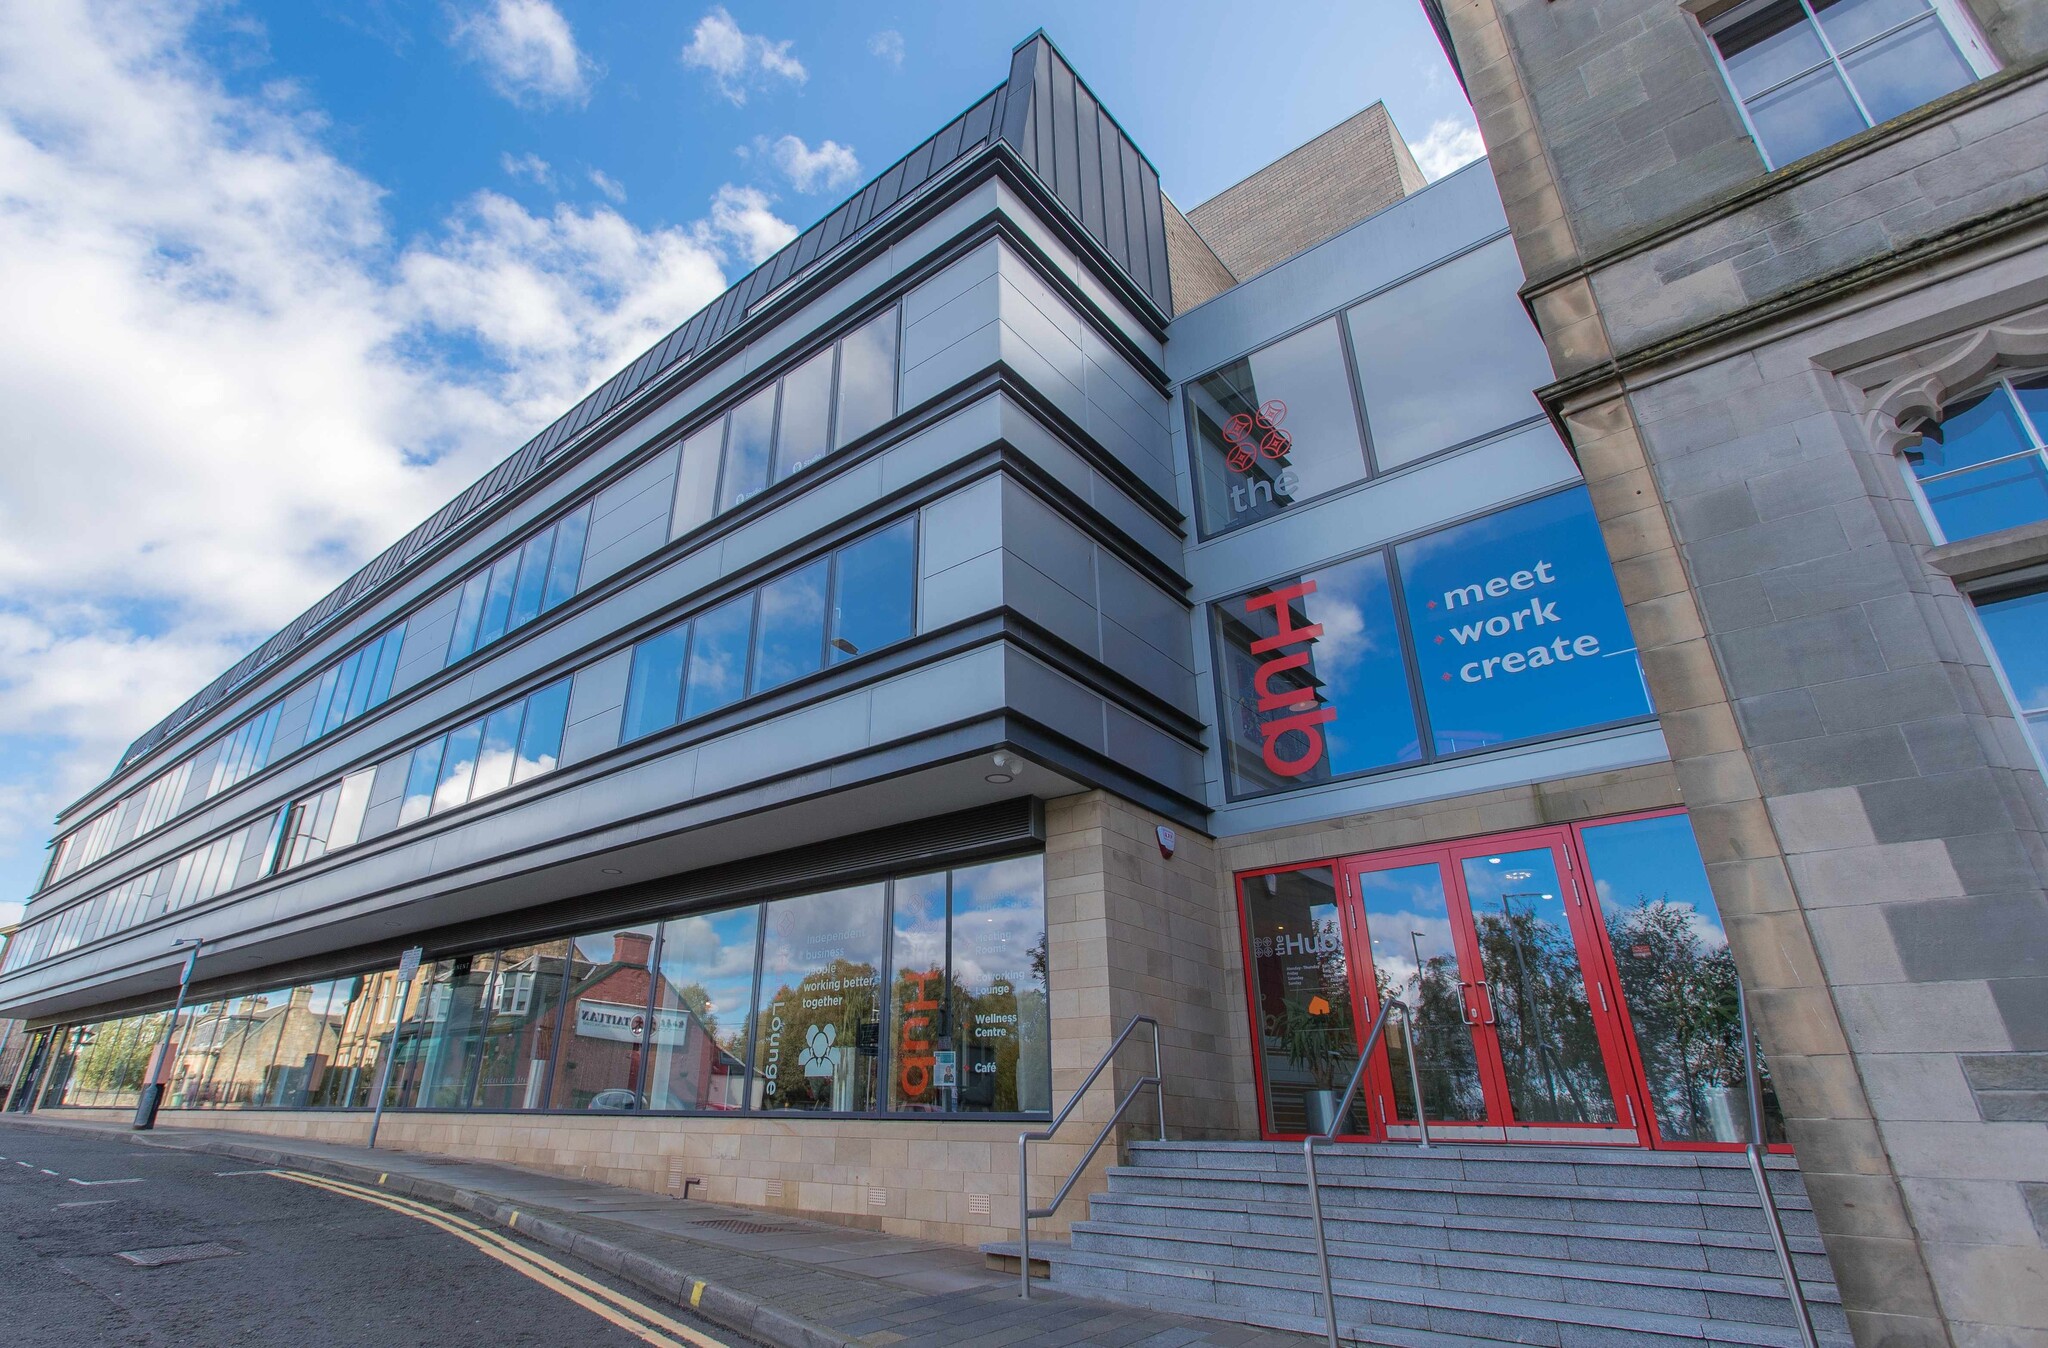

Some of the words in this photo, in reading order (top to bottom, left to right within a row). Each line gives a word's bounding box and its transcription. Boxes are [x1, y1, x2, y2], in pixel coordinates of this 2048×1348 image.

[1230, 471, 1299, 513] the
[1444, 560, 1555, 610] meet
[1449, 597, 1562, 645] work
[1460, 634, 1600, 683] create
[1245, 580, 1338, 777] Hub
[806, 929, 865, 945] Independent
[1275, 935, 1286, 956] the
[1286, 933, 1338, 956] Hub
[805, 947, 845, 960] business
[975, 944, 1007, 955] Rooms
[803, 963, 837, 977] people
[803, 979, 841, 992] working
[843, 976, 876, 989] better,
[975, 985, 1010, 996] Lounge
[802, 995, 843, 1010] together
[975, 1013, 1018, 1025] Wellness
[901, 970, 939, 1096] Hub
[975, 1027, 1007, 1038] Centre
[765, 1001, 785, 1096] Lounge
[974, 1062, 997, 1074] Café
